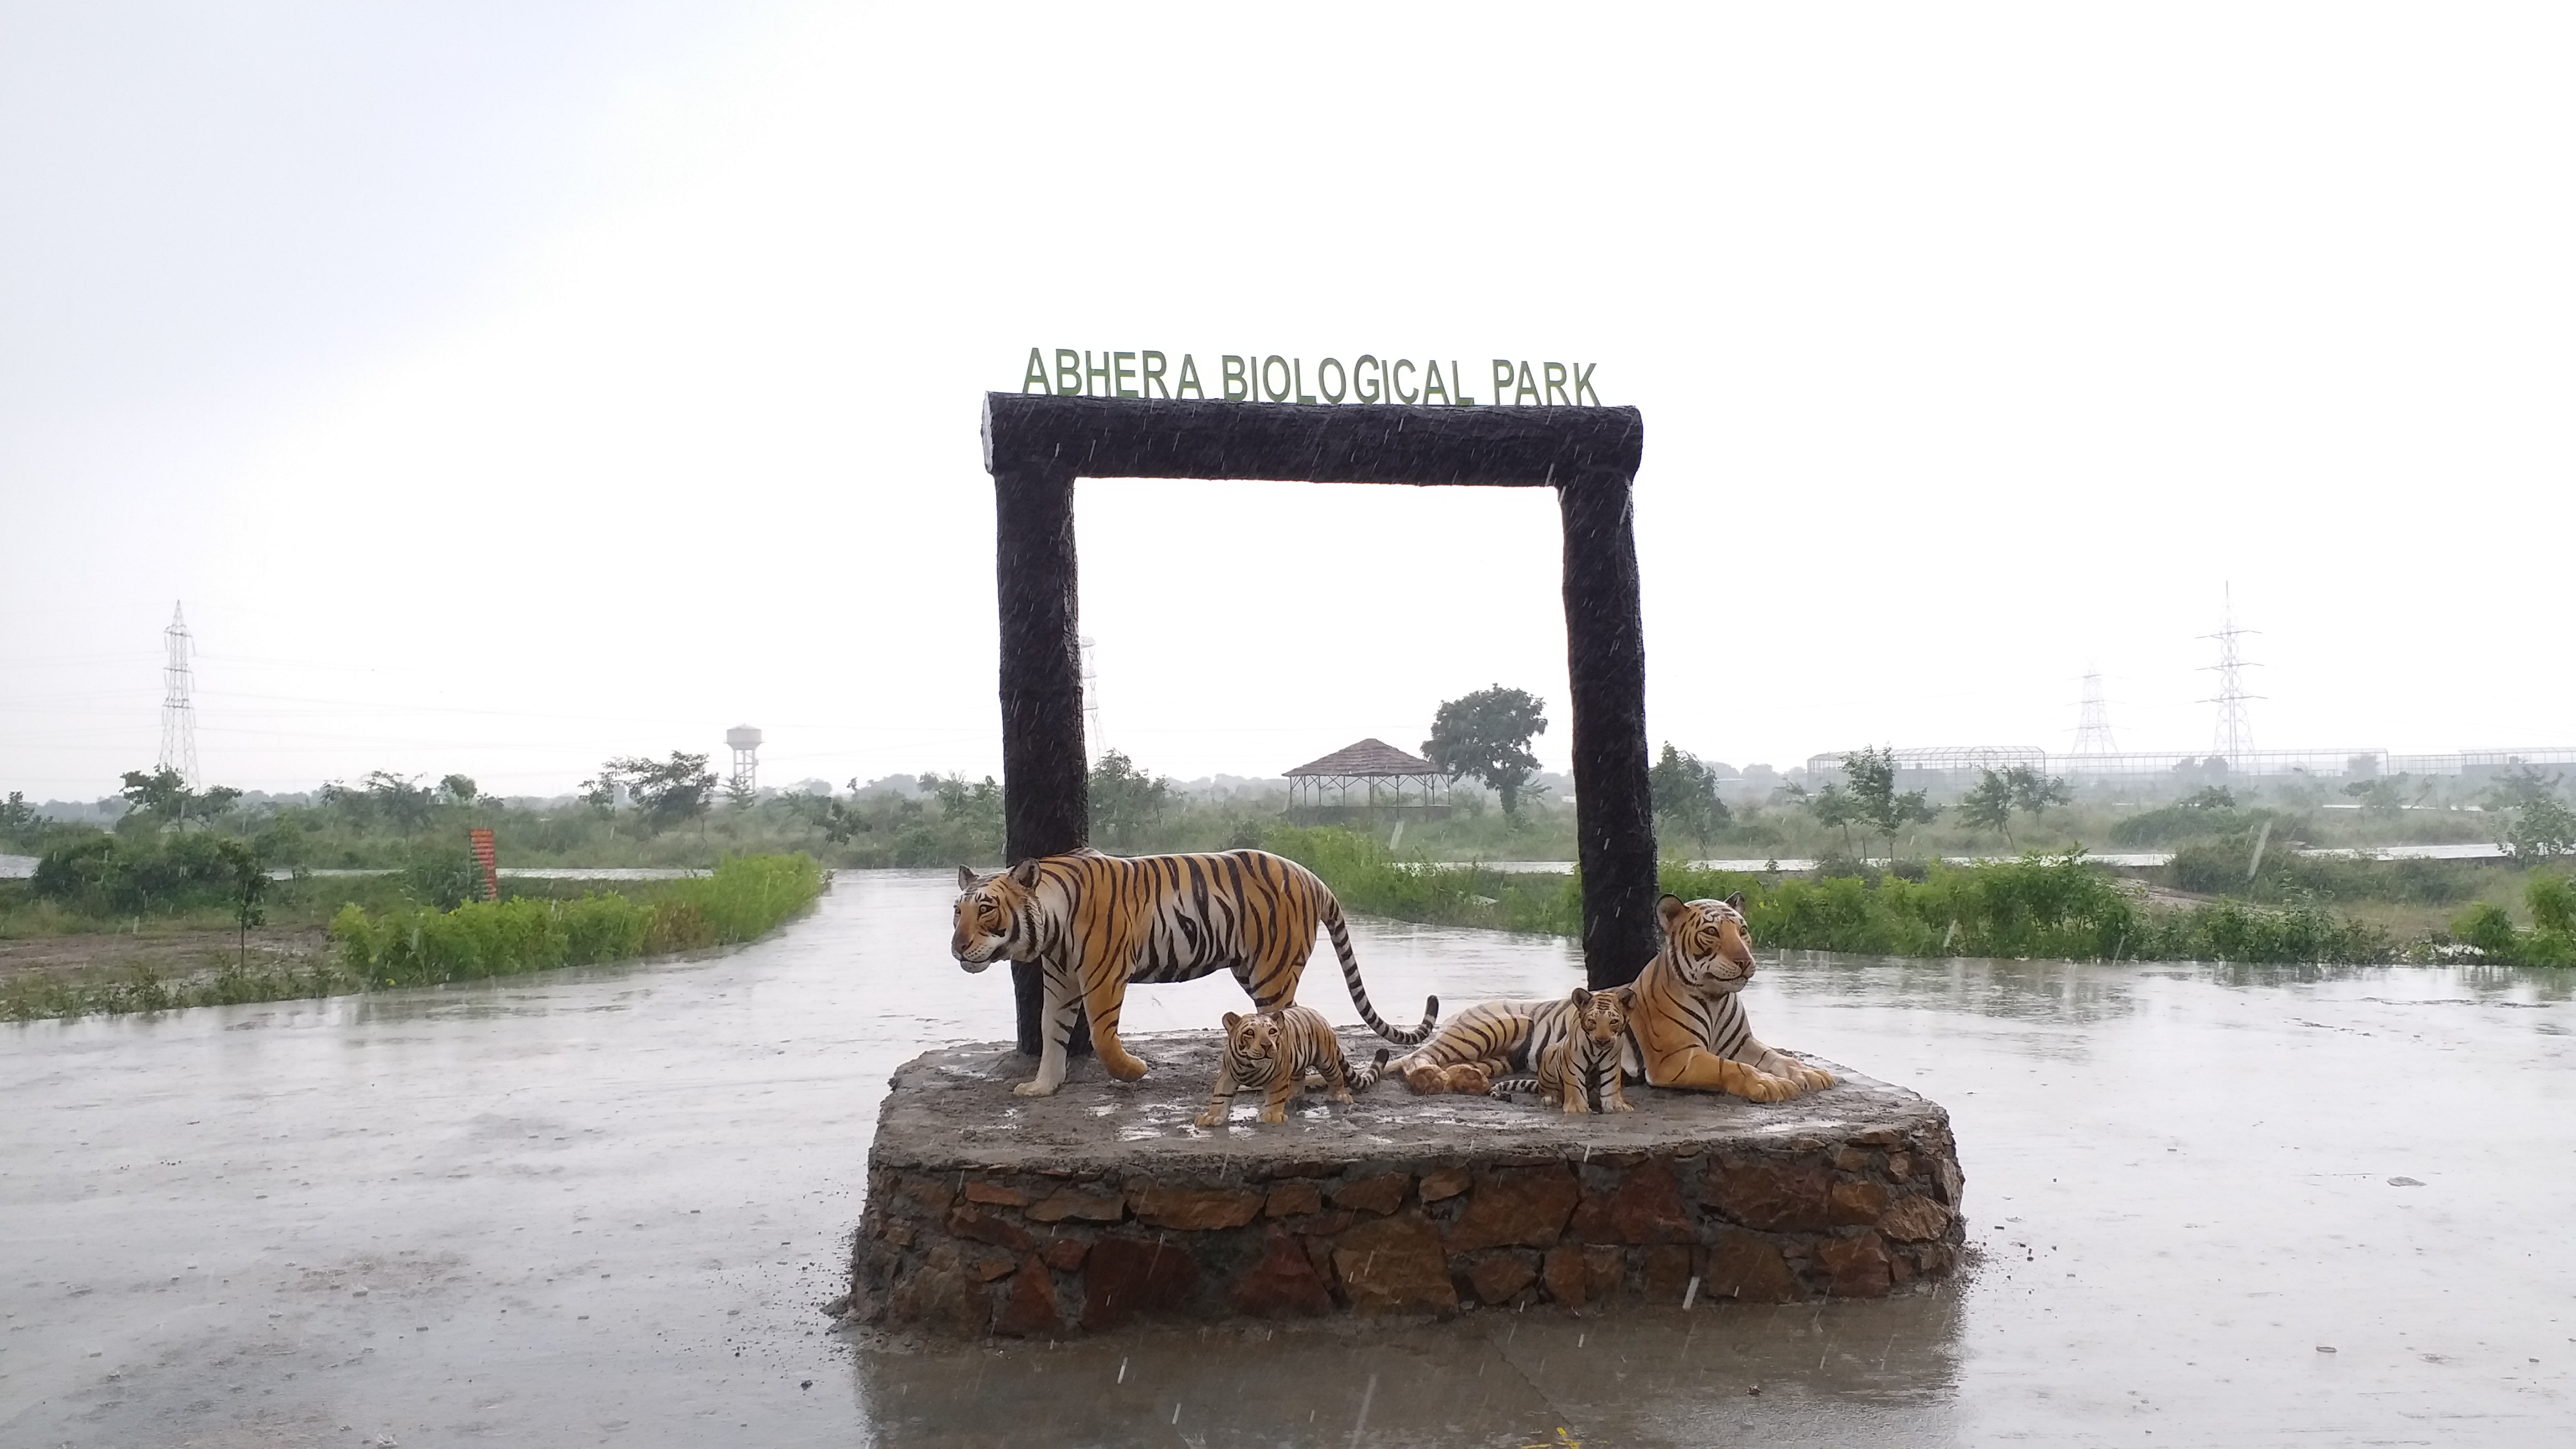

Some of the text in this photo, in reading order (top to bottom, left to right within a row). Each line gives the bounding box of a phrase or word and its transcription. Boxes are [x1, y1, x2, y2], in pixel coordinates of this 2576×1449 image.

[1022, 347, 1603, 407] ABHERA BIOLOGICAL PARK
